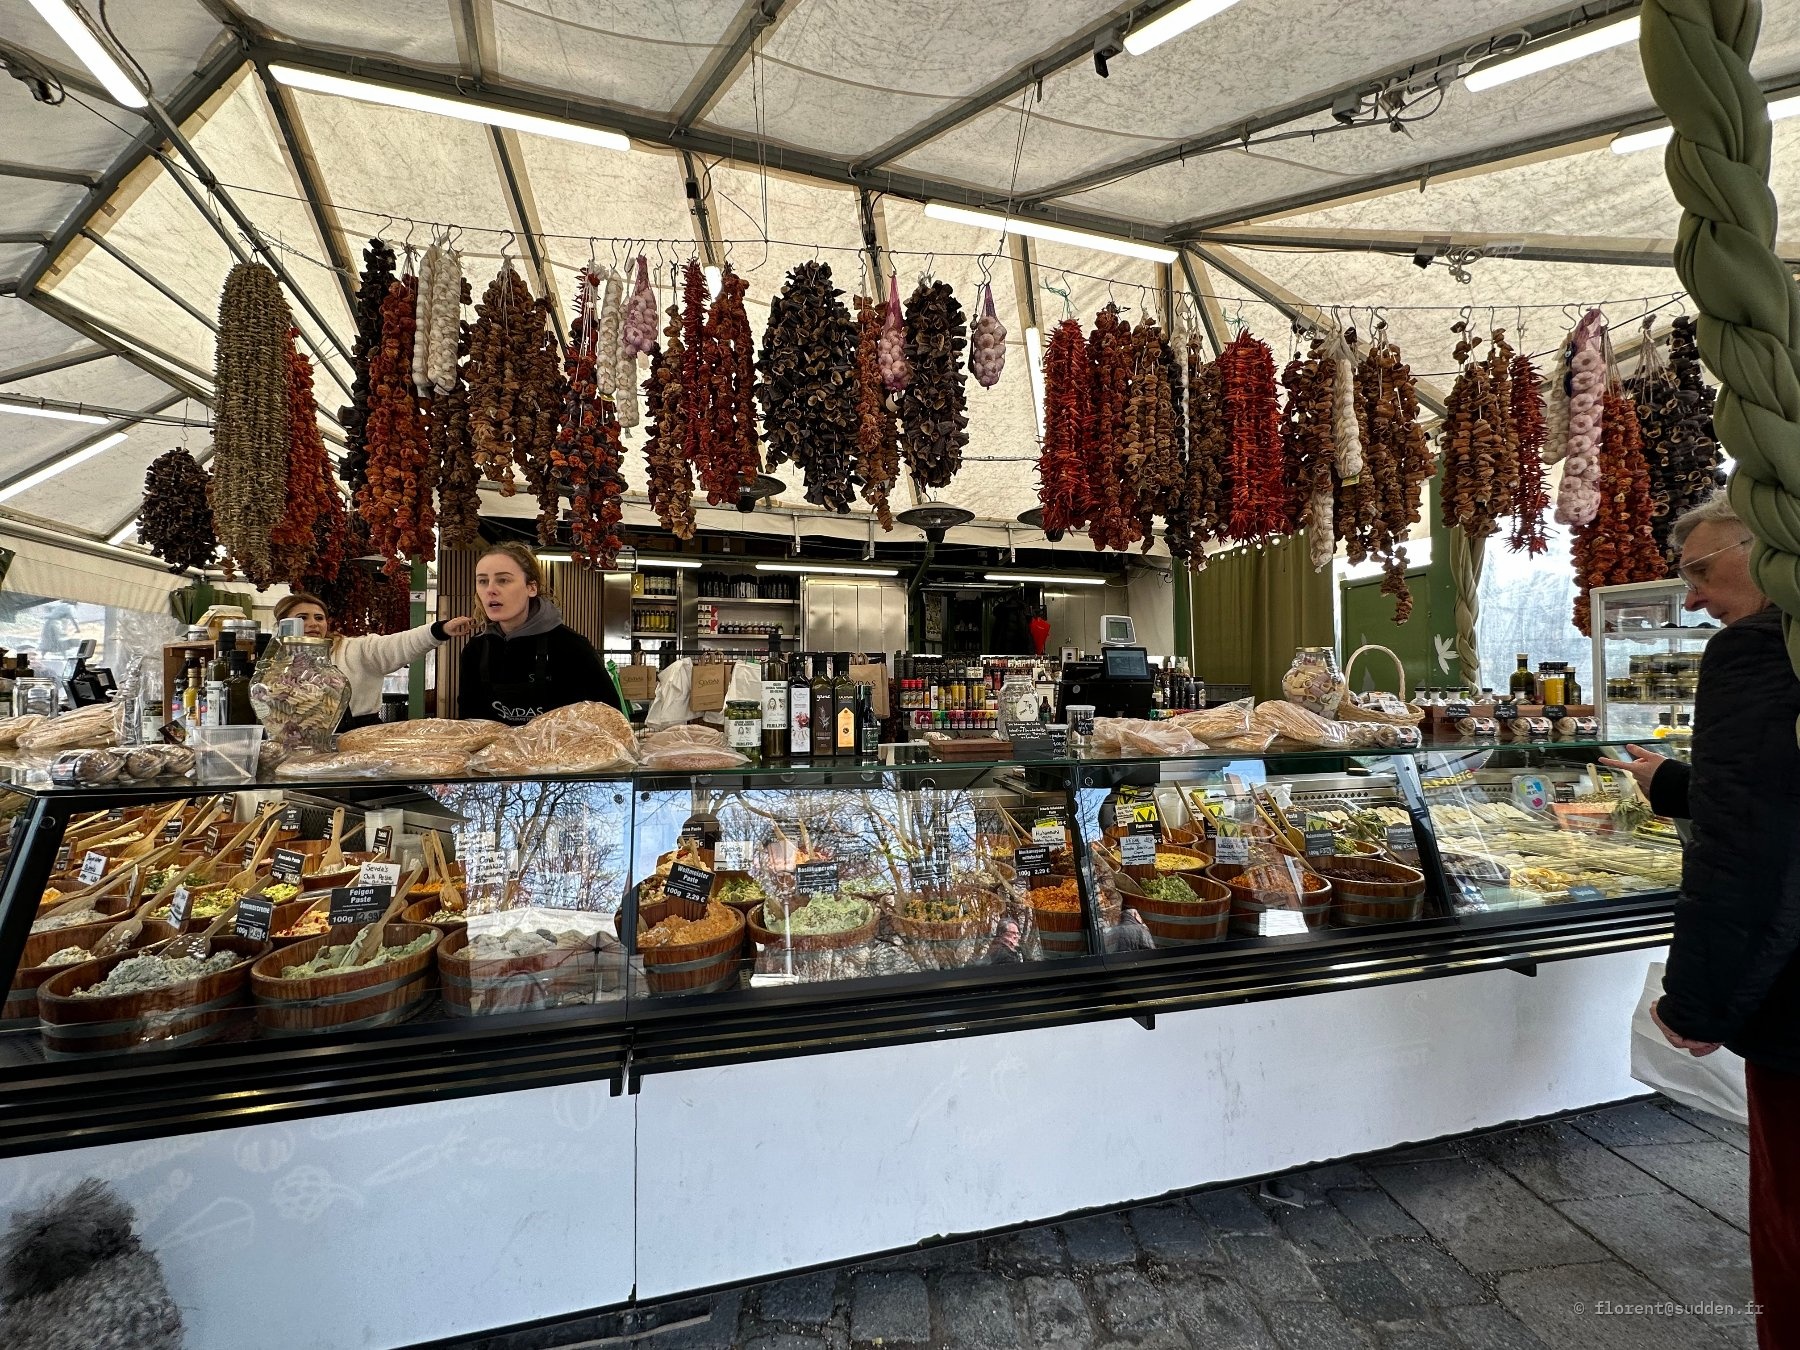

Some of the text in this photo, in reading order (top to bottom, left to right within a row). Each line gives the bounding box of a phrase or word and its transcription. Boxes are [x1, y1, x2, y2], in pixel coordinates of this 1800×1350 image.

[492, 701, 543, 718] SEVDAS
[683, 874, 698, 884] Paste
[349, 888, 374, 896] Feigen
[667, 887, 681, 897] 100g
[350, 896, 371, 904] Paste
[239, 901, 271, 914] Sommercreme
